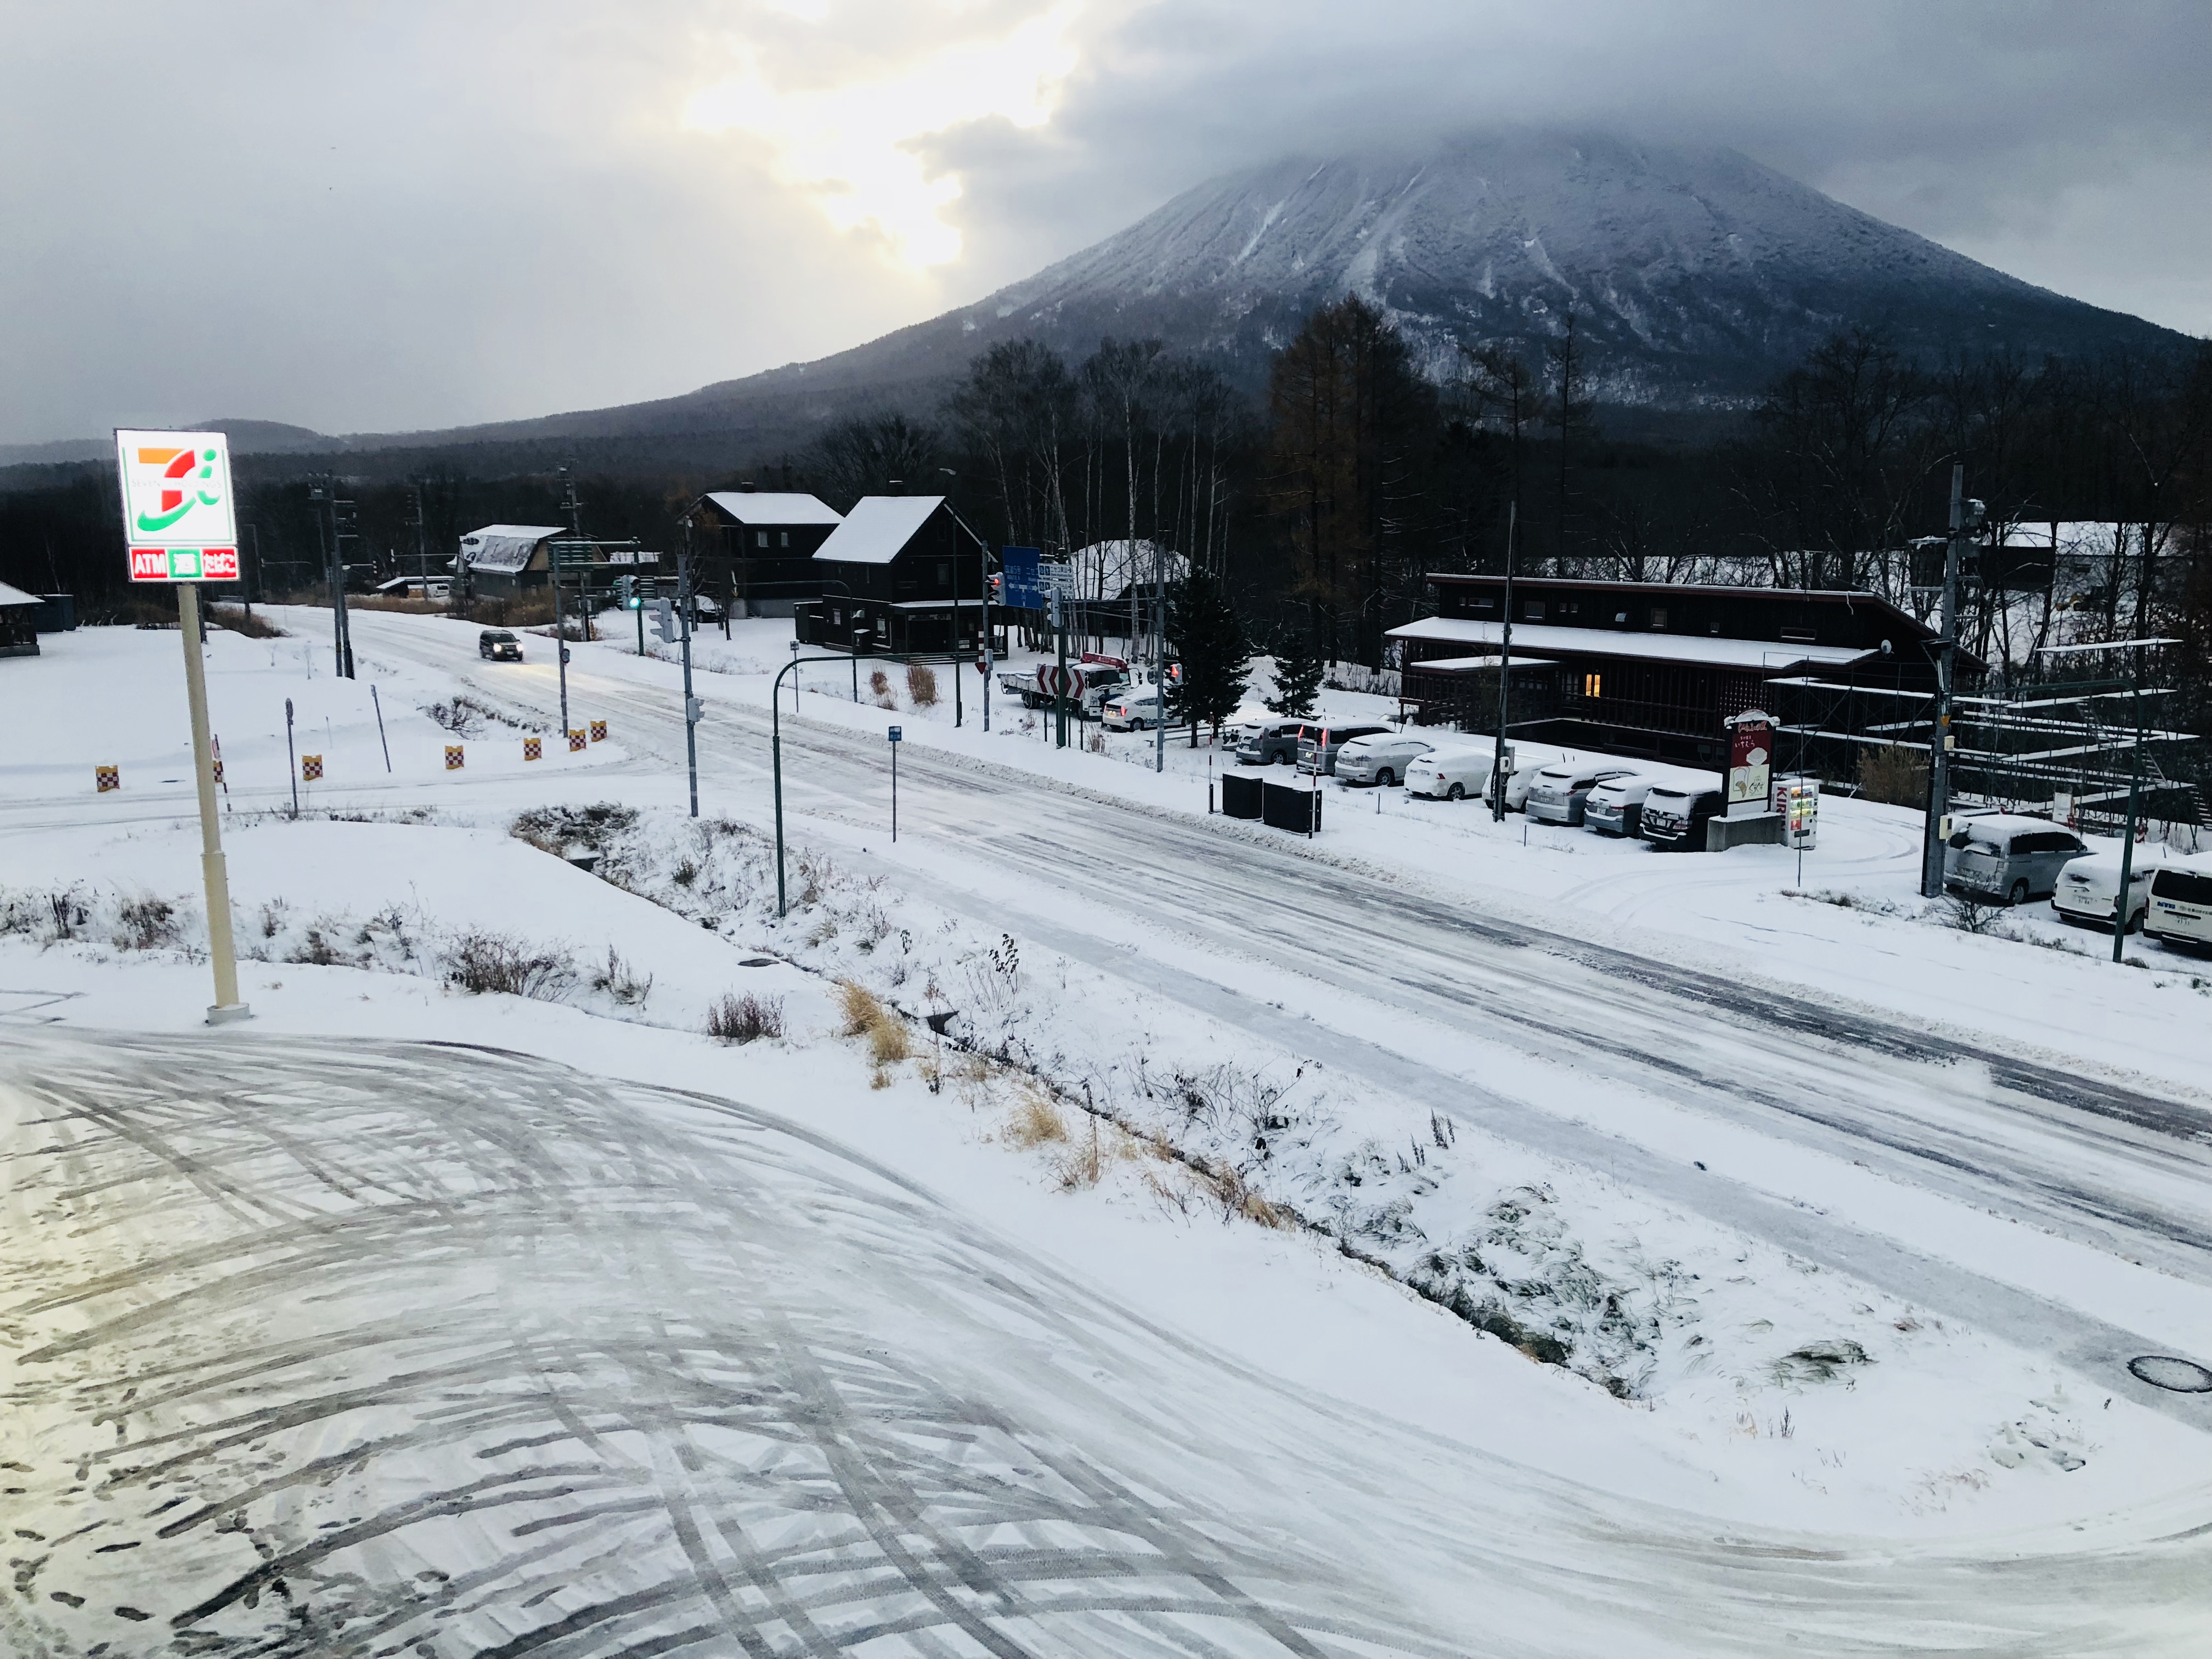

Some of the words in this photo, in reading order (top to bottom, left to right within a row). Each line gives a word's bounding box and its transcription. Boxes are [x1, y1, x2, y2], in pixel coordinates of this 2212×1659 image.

[135, 554, 165, 573] ATM
[204, 553, 236, 573] たばこ
